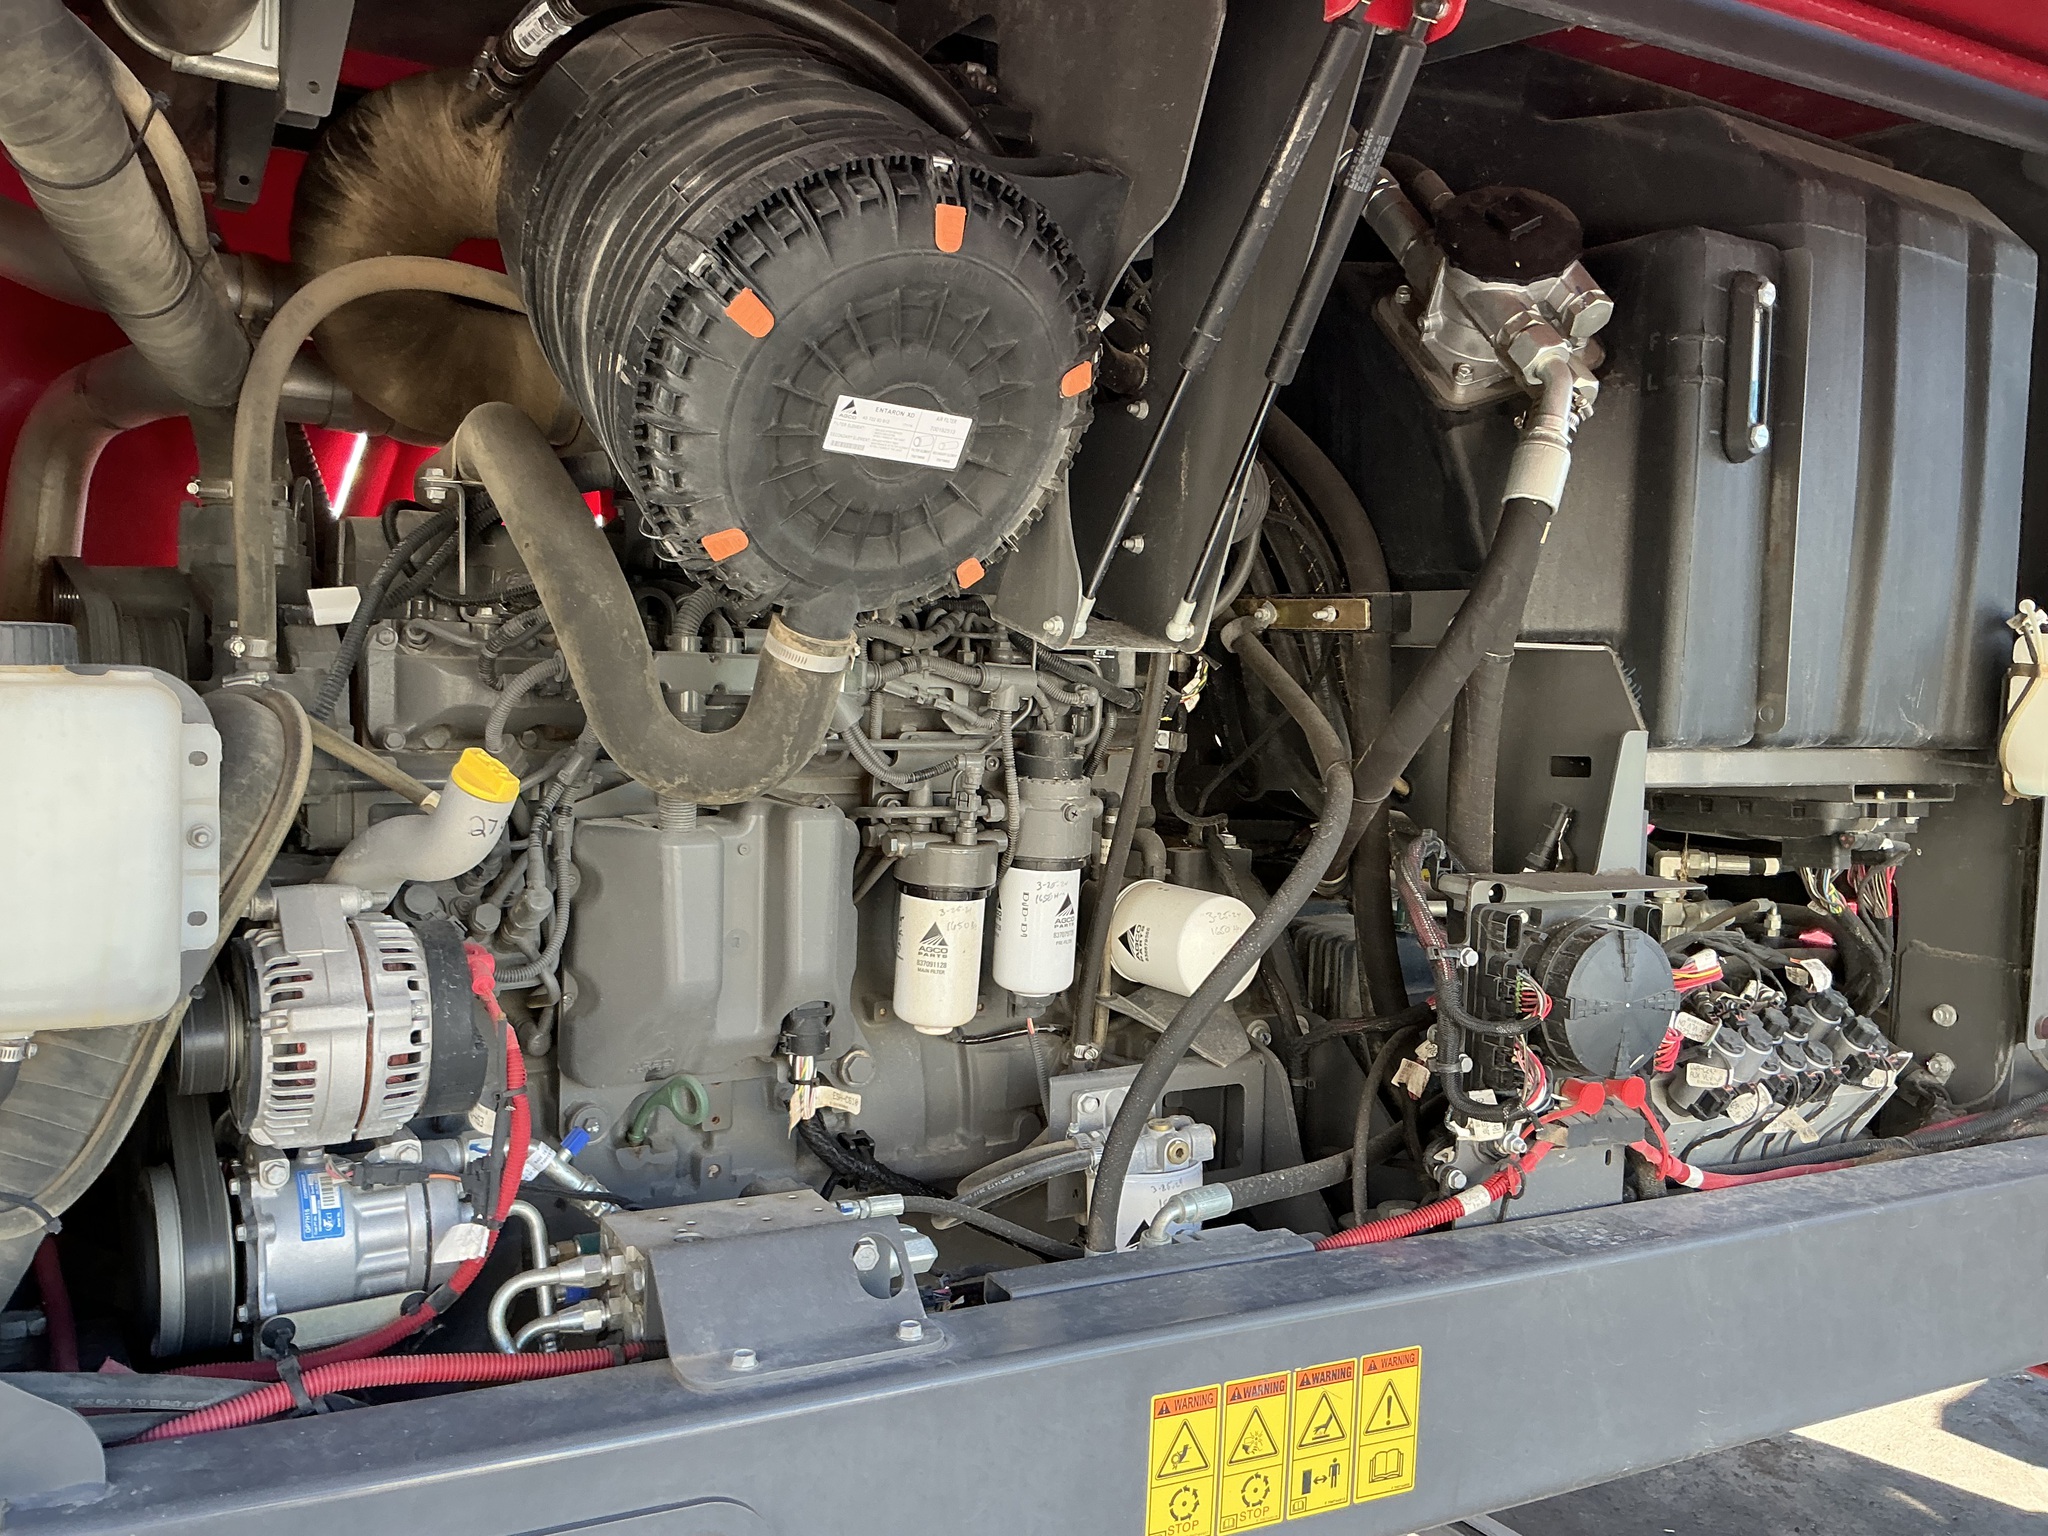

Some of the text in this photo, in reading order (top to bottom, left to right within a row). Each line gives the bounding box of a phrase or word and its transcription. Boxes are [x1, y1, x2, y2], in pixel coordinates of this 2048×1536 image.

[875, 406, 916, 419] ENTARON XD
[1054, 916, 1075, 924] AGCO
[918, 945, 949, 954] AGCO
[1134, 924, 1143, 961] AGCO
[917, 951, 948, 959] PARTS
[1381, 1352, 1415, 1369] WARNING
[1311, 1366, 1353, 1385] WARNING
[1243, 1379, 1285, 1399] WARNING
[1174, 1392, 1214, 1411] WARNING
[1239, 1506, 1270, 1523] STOP
[1167, 1519, 1199, 1536] STOP
